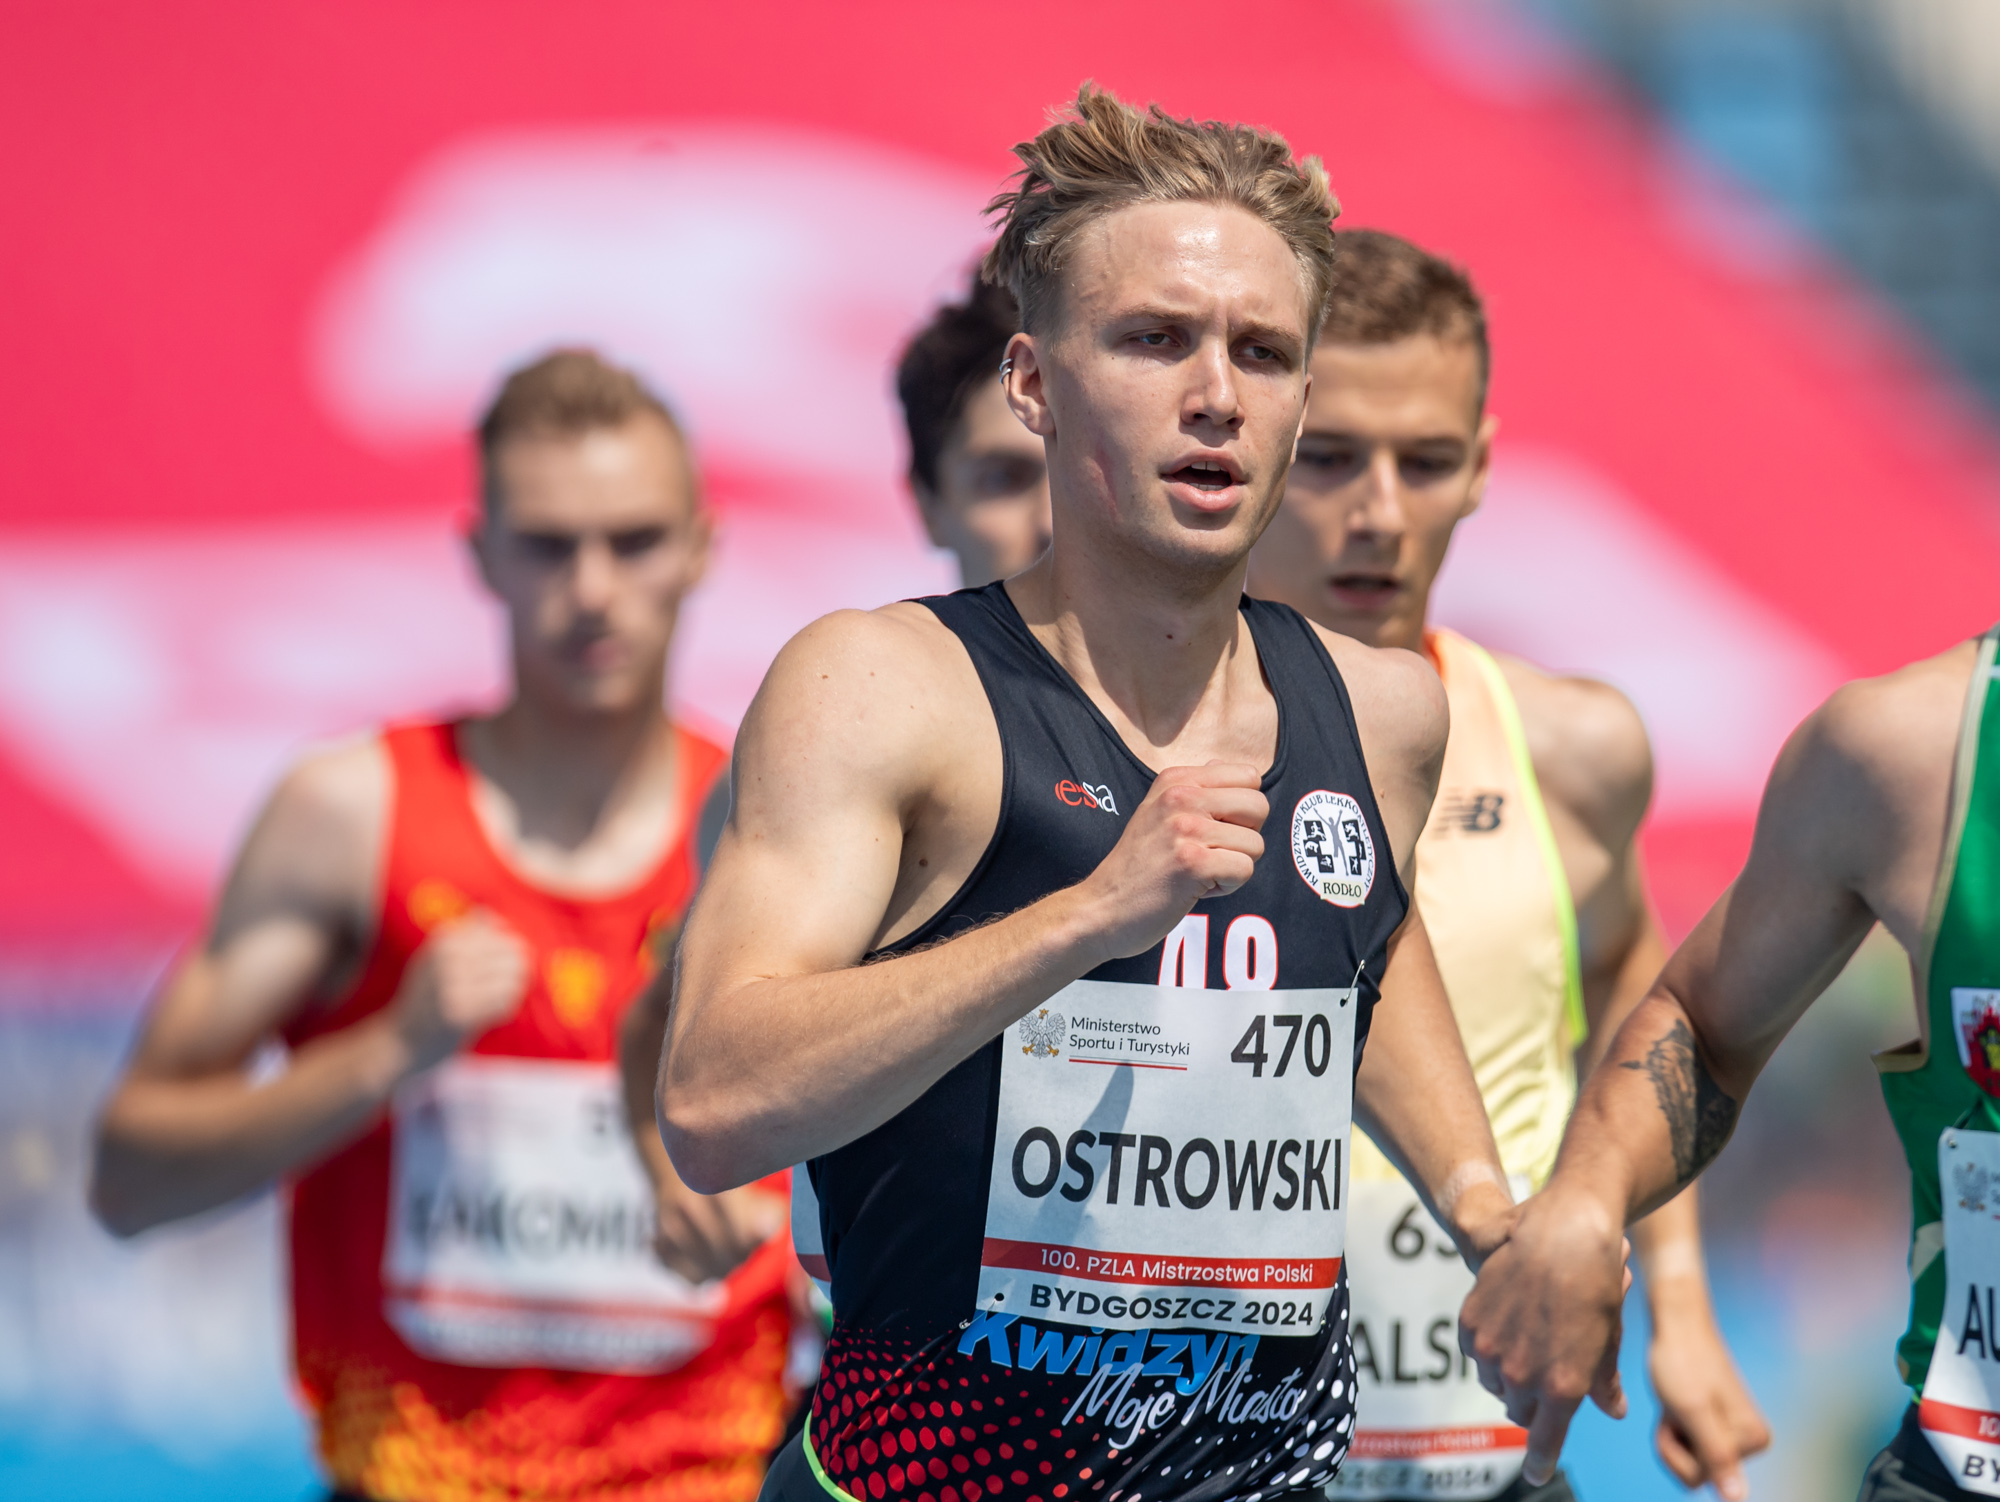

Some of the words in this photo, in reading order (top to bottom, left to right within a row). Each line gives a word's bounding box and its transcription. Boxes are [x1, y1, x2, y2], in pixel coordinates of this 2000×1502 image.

[1055, 779, 1120, 815] esa
[1300, 794, 1323, 814] KLUB
[1323, 882, 1362, 898] RODŁO
[1071, 1016, 1161, 1035] Ministerstwo
[1069, 1034, 1115, 1050] Sportu
[1119, 1038, 1123, 1050] i
[1127, 1038, 1190, 1056] Turystyki
[1230, 1013, 1331, 1078] 470
[1011, 1126, 1341, 1211] OSTROWSKI
[1040, 1248, 1080, 1271] 100.
[1086, 1257, 1136, 1278] PZLA
[1141, 1261, 1259, 1283] Mistrzostwa
[1263, 1264, 1313, 1283] Polski
[1029, 1284, 1236, 1322] BYDGOSZCZ
[1241, 1302, 1313, 1326] 2024
[1061, 1363, 1177, 1450] Moje
[1180, 1358, 1306, 1426] Miasto
